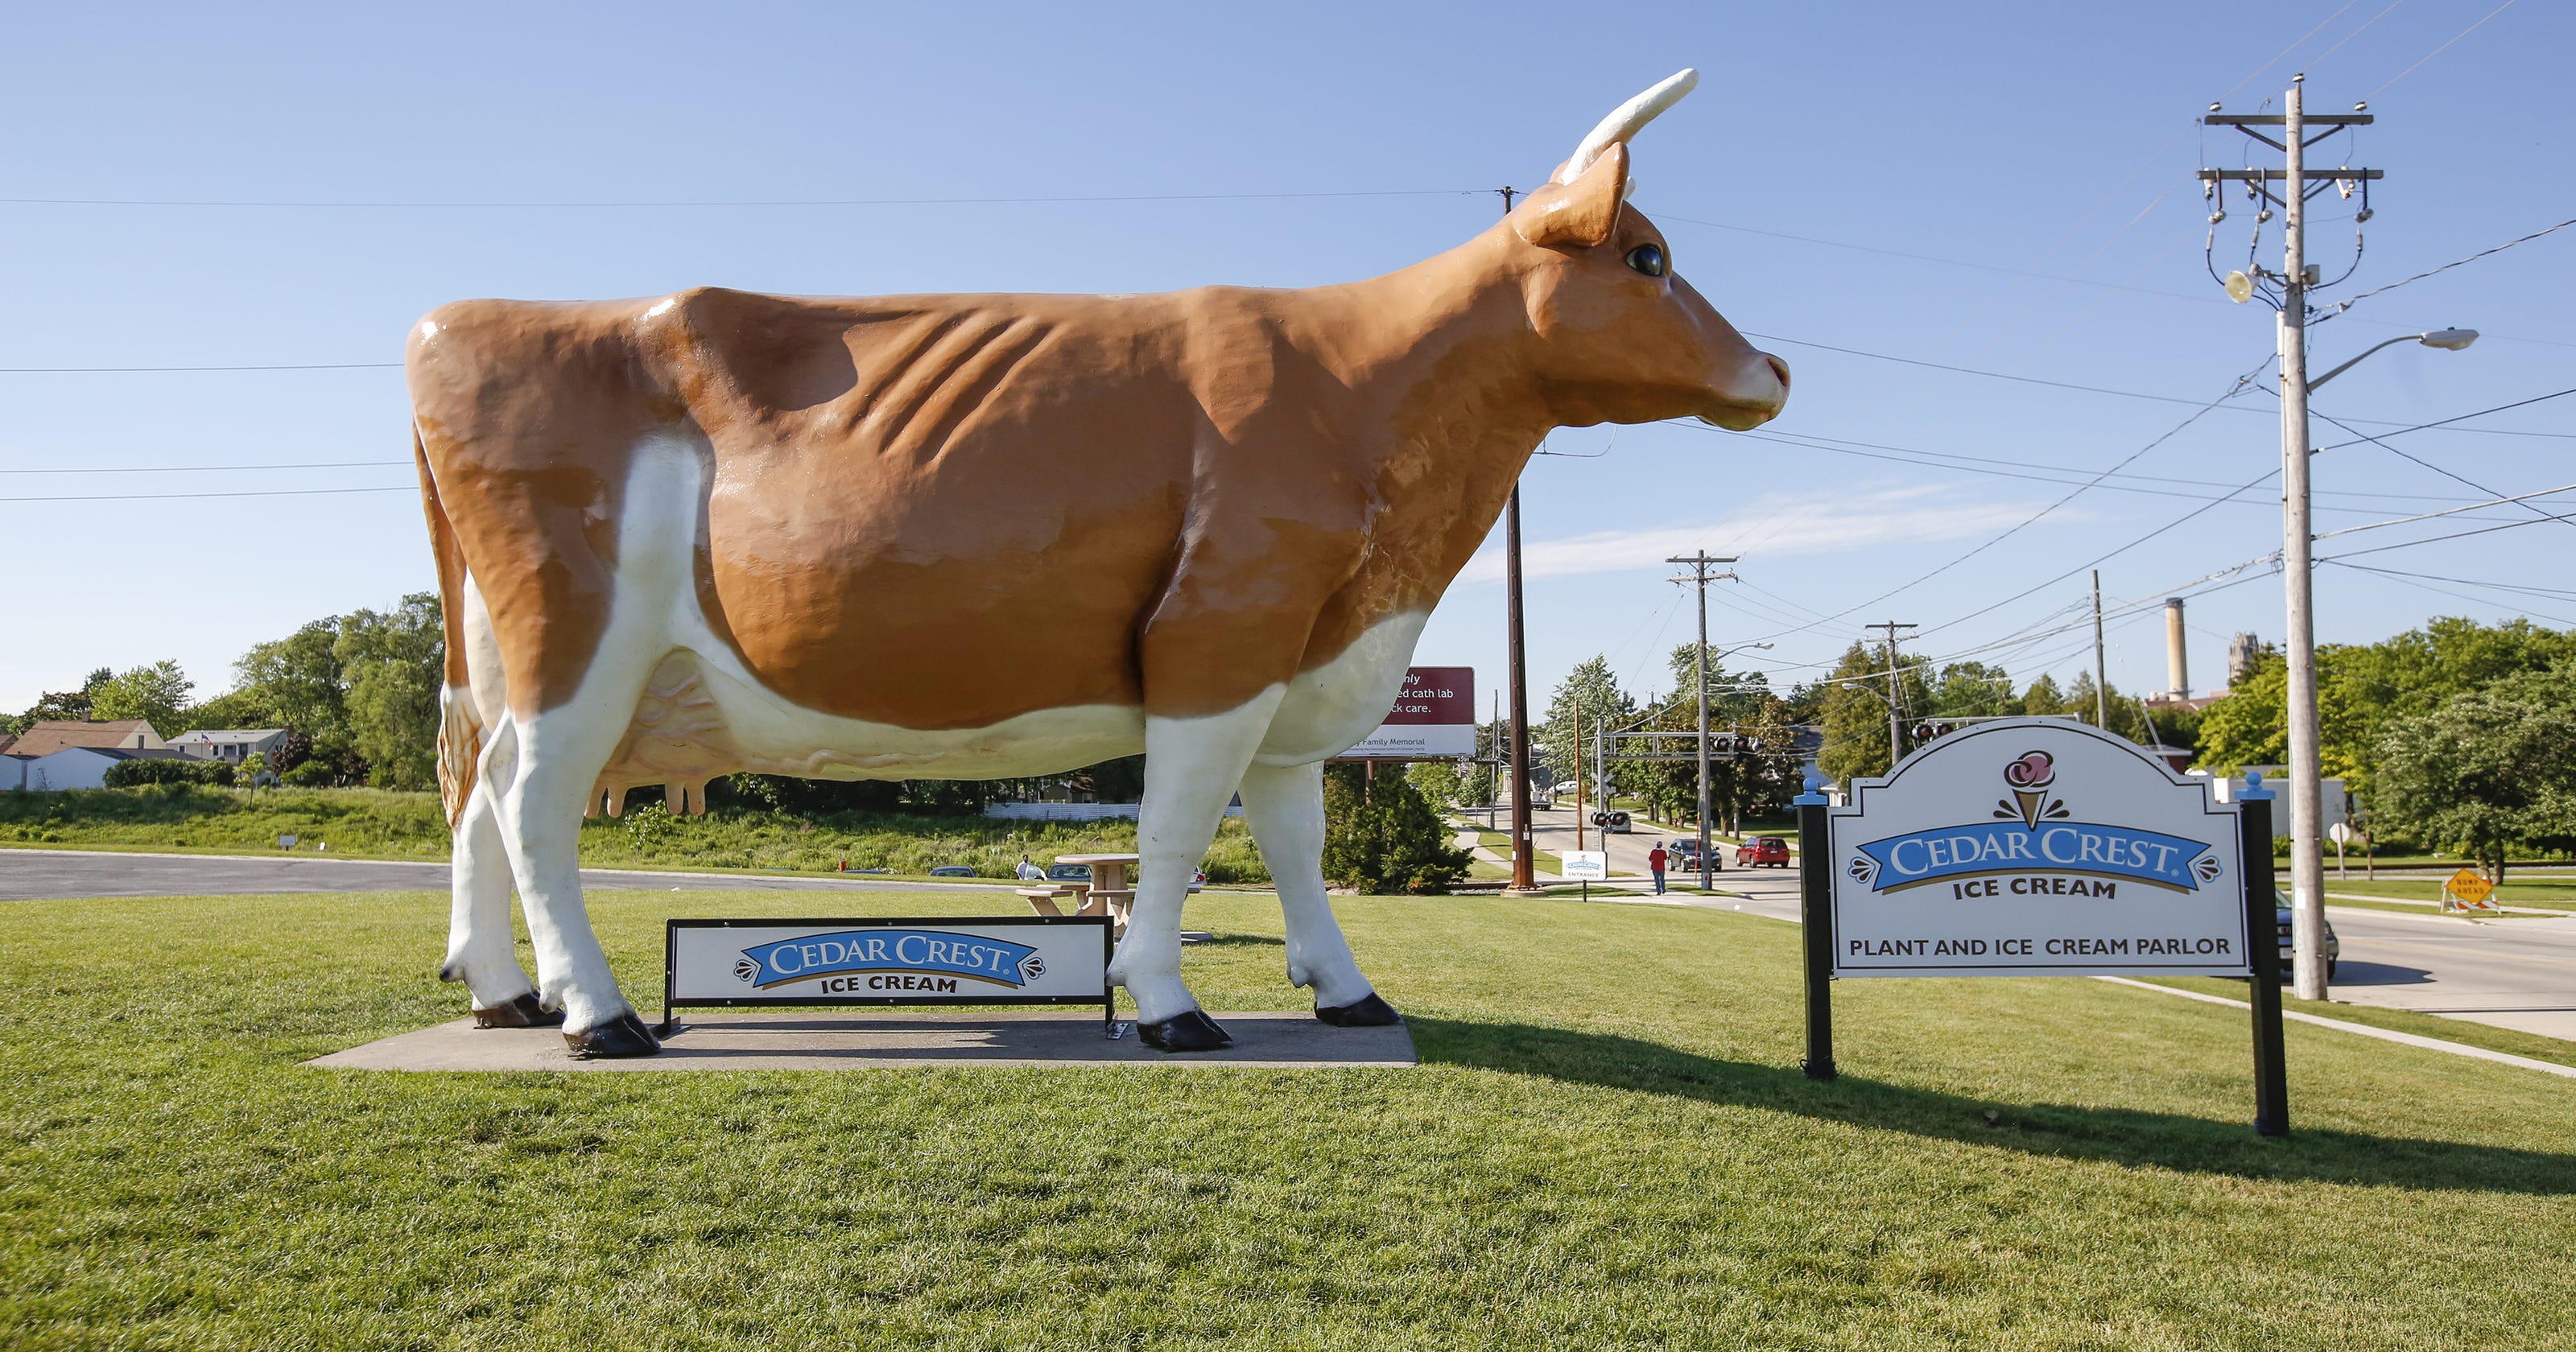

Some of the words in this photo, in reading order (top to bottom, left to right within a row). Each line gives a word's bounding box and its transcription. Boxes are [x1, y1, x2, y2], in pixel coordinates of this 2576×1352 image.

[1403, 674, 1421, 685] nly
[1412, 689, 1435, 699] cath
[1438, 689, 1454, 699] lab
[1406, 705, 1431, 713] care.
[1363, 739, 1388, 747] Family
[1389, 738, 1425, 746] Memorial
[1890, 832, 2037, 875] CEDAR
[1953, 879, 2000, 901] ICE
[2010, 878, 2116, 900] CREAM
[1850, 939, 1930, 956] PLANT
[1934, 939, 1988, 956] AND
[1995, 939, 2033, 955] ICE
[2046, 938, 2128, 955] CREAM
[2136, 938, 2231, 954] PARLOR
[770, 938, 893, 975] CEDAR
[821, 977, 860, 994] ICE
[868, 975, 957, 994] CREAM
